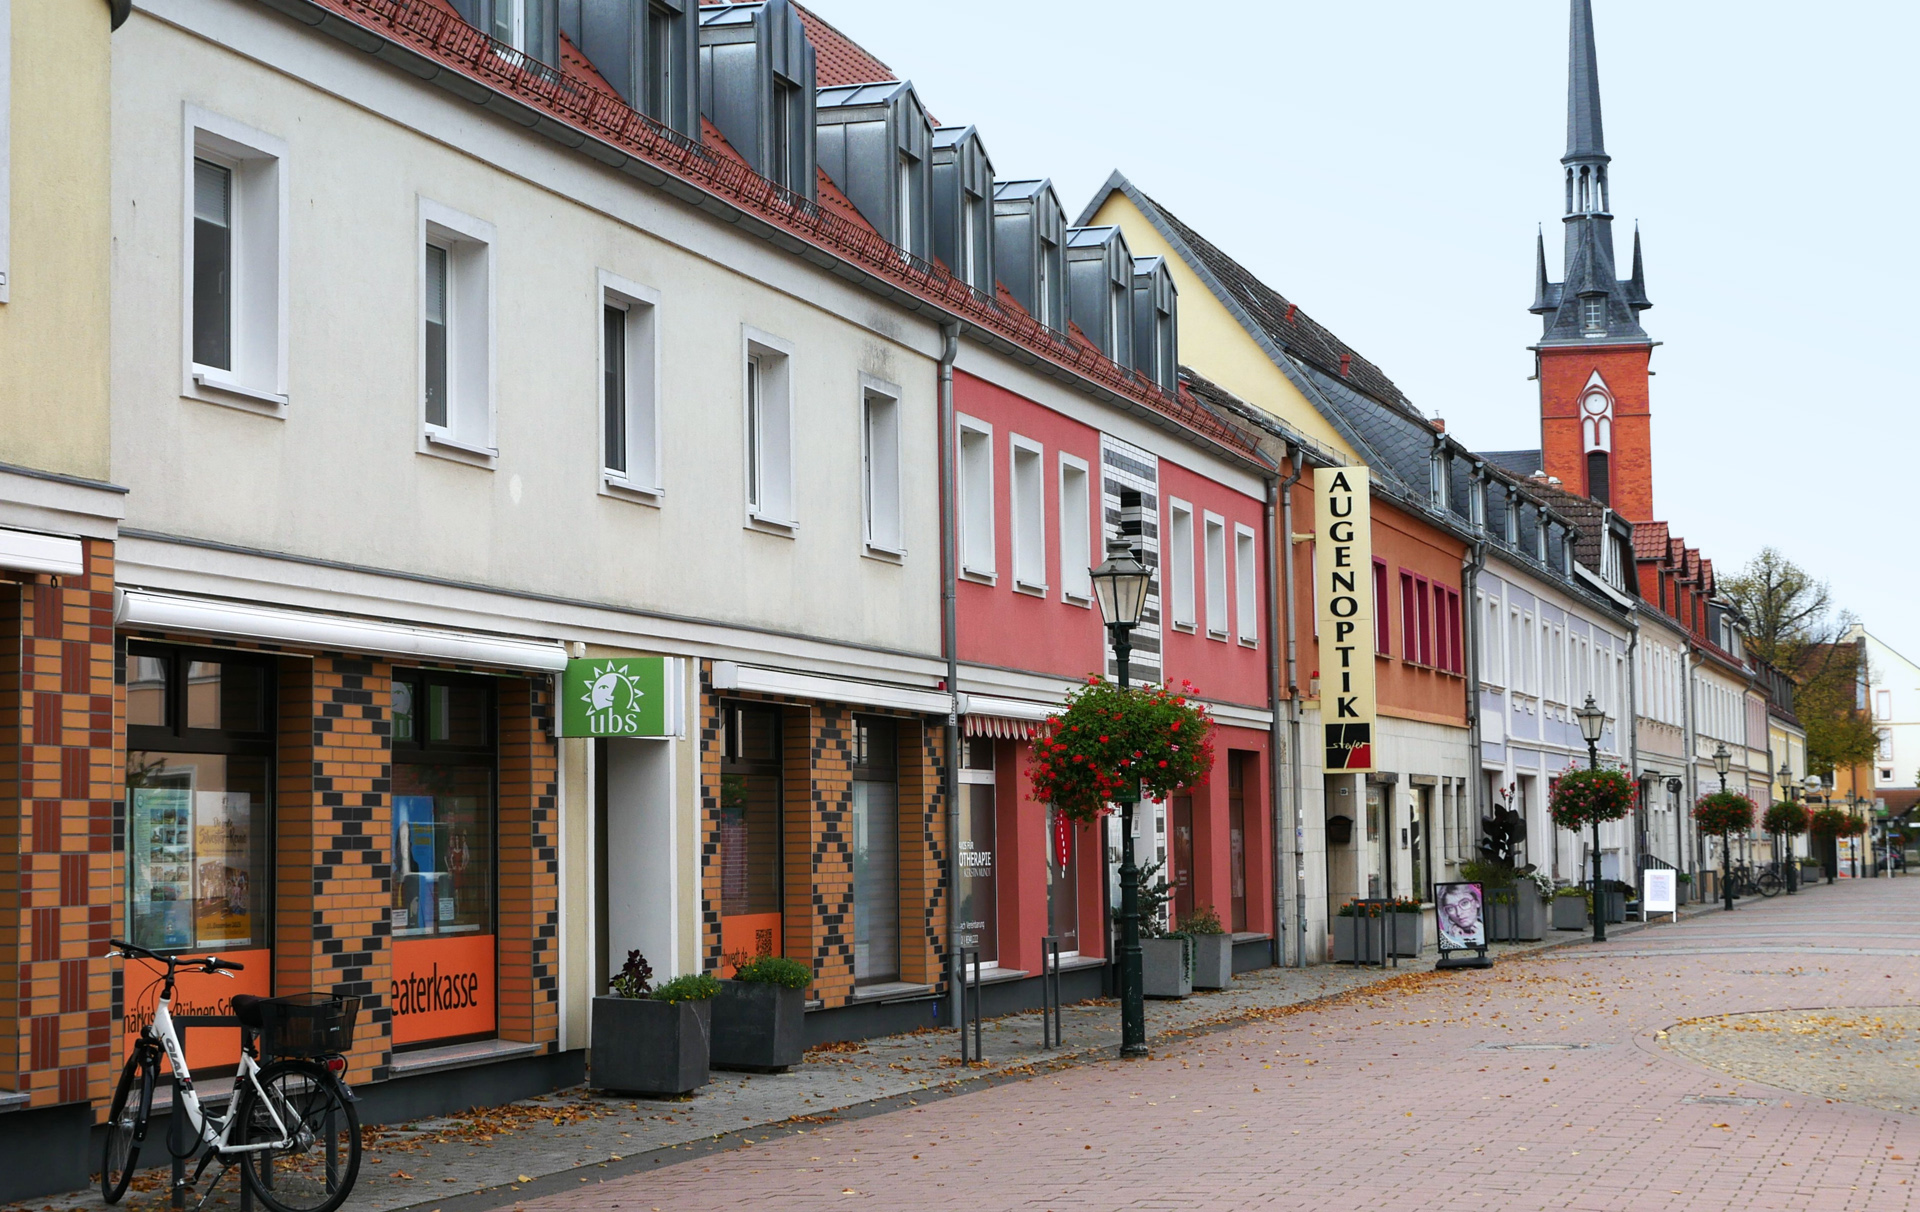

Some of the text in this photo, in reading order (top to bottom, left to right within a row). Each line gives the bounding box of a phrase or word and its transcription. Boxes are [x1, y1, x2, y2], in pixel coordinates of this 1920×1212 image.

[1329, 471, 1359, 718] AUGENOPTIK
[590, 707, 638, 734] ubs
[959, 852, 991, 866] OTHERAPIE
[391, 962, 478, 1016] eaterkasse
[165, 1037, 192, 1098] GIANT
